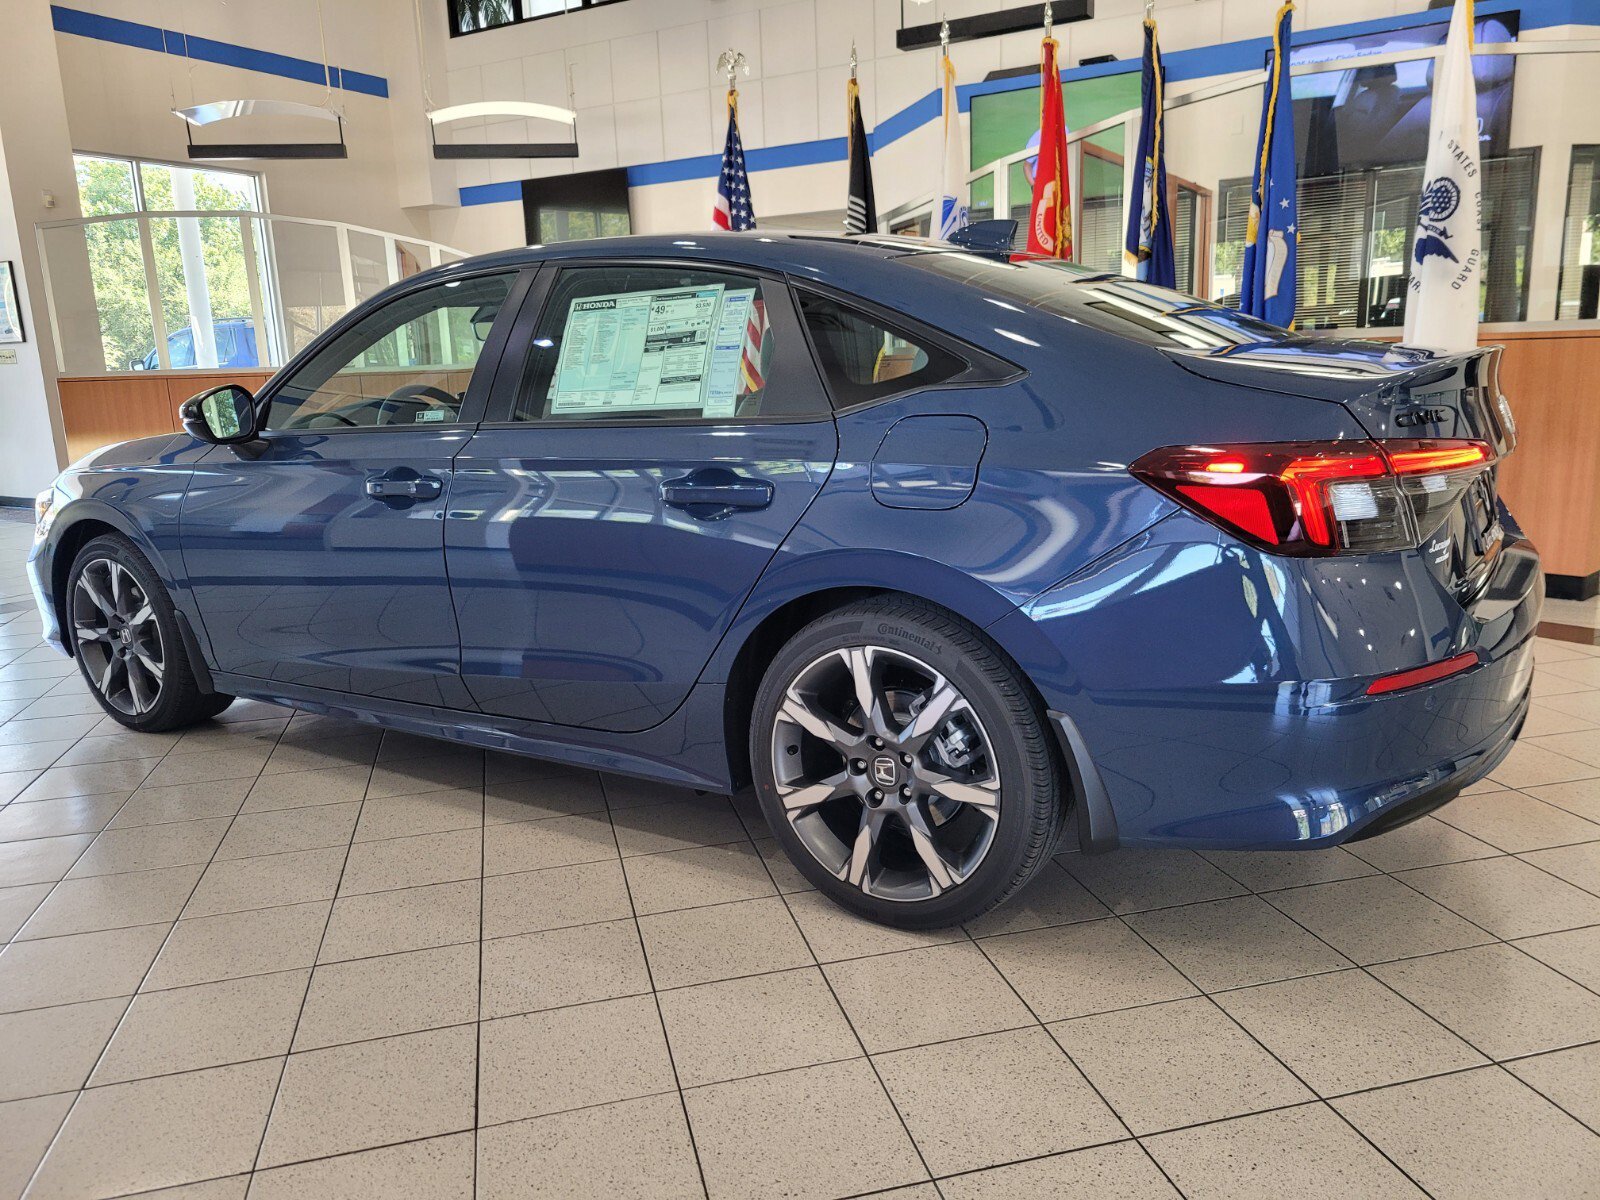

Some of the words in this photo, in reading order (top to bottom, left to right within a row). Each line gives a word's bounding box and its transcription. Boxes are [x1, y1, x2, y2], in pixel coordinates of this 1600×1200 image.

[1447, 139, 1478, 178] STATES
[1037, 213, 1049, 246] UNITED
[1451, 248, 1480, 290] GUARD
[582, 300, 616, 310] HONDA
[654, 305, 666, 315] 49
[877, 622, 937, 652] Continental
